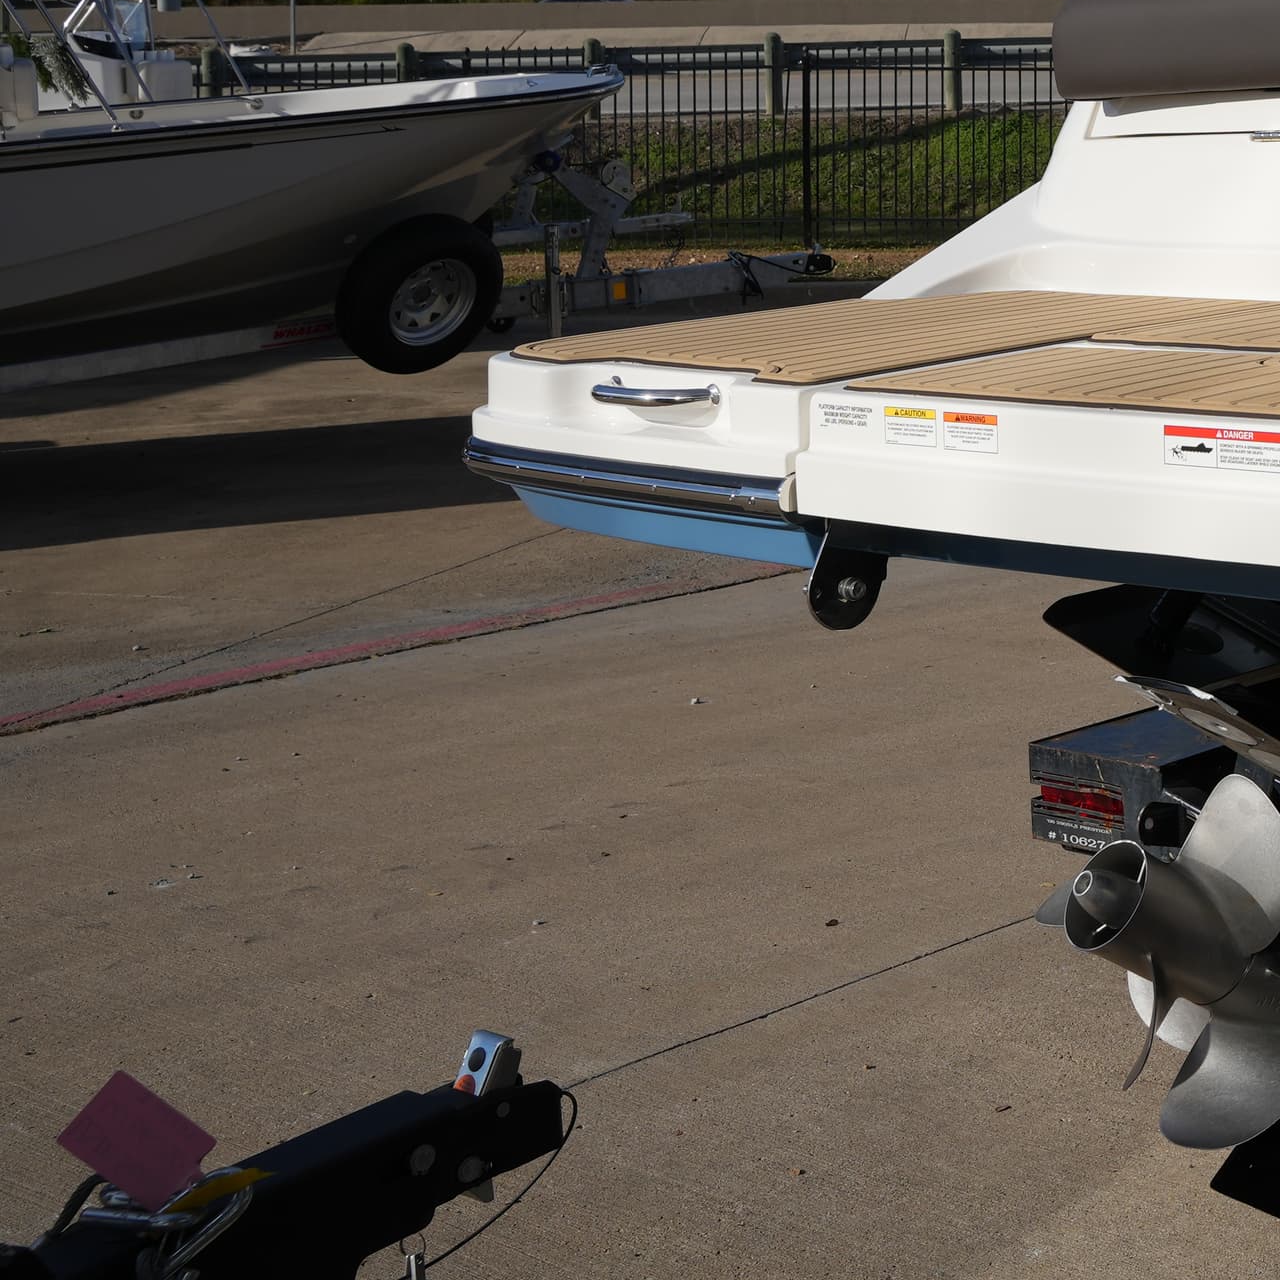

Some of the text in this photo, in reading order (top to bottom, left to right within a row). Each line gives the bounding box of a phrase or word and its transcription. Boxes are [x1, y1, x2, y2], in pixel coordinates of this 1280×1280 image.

[899, 409, 927, 418] CAUTION
[960, 416, 986, 424] WARNING
[1223, 430, 1254, 440] DANGER
[1048, 830, 1106, 849] # 10627
